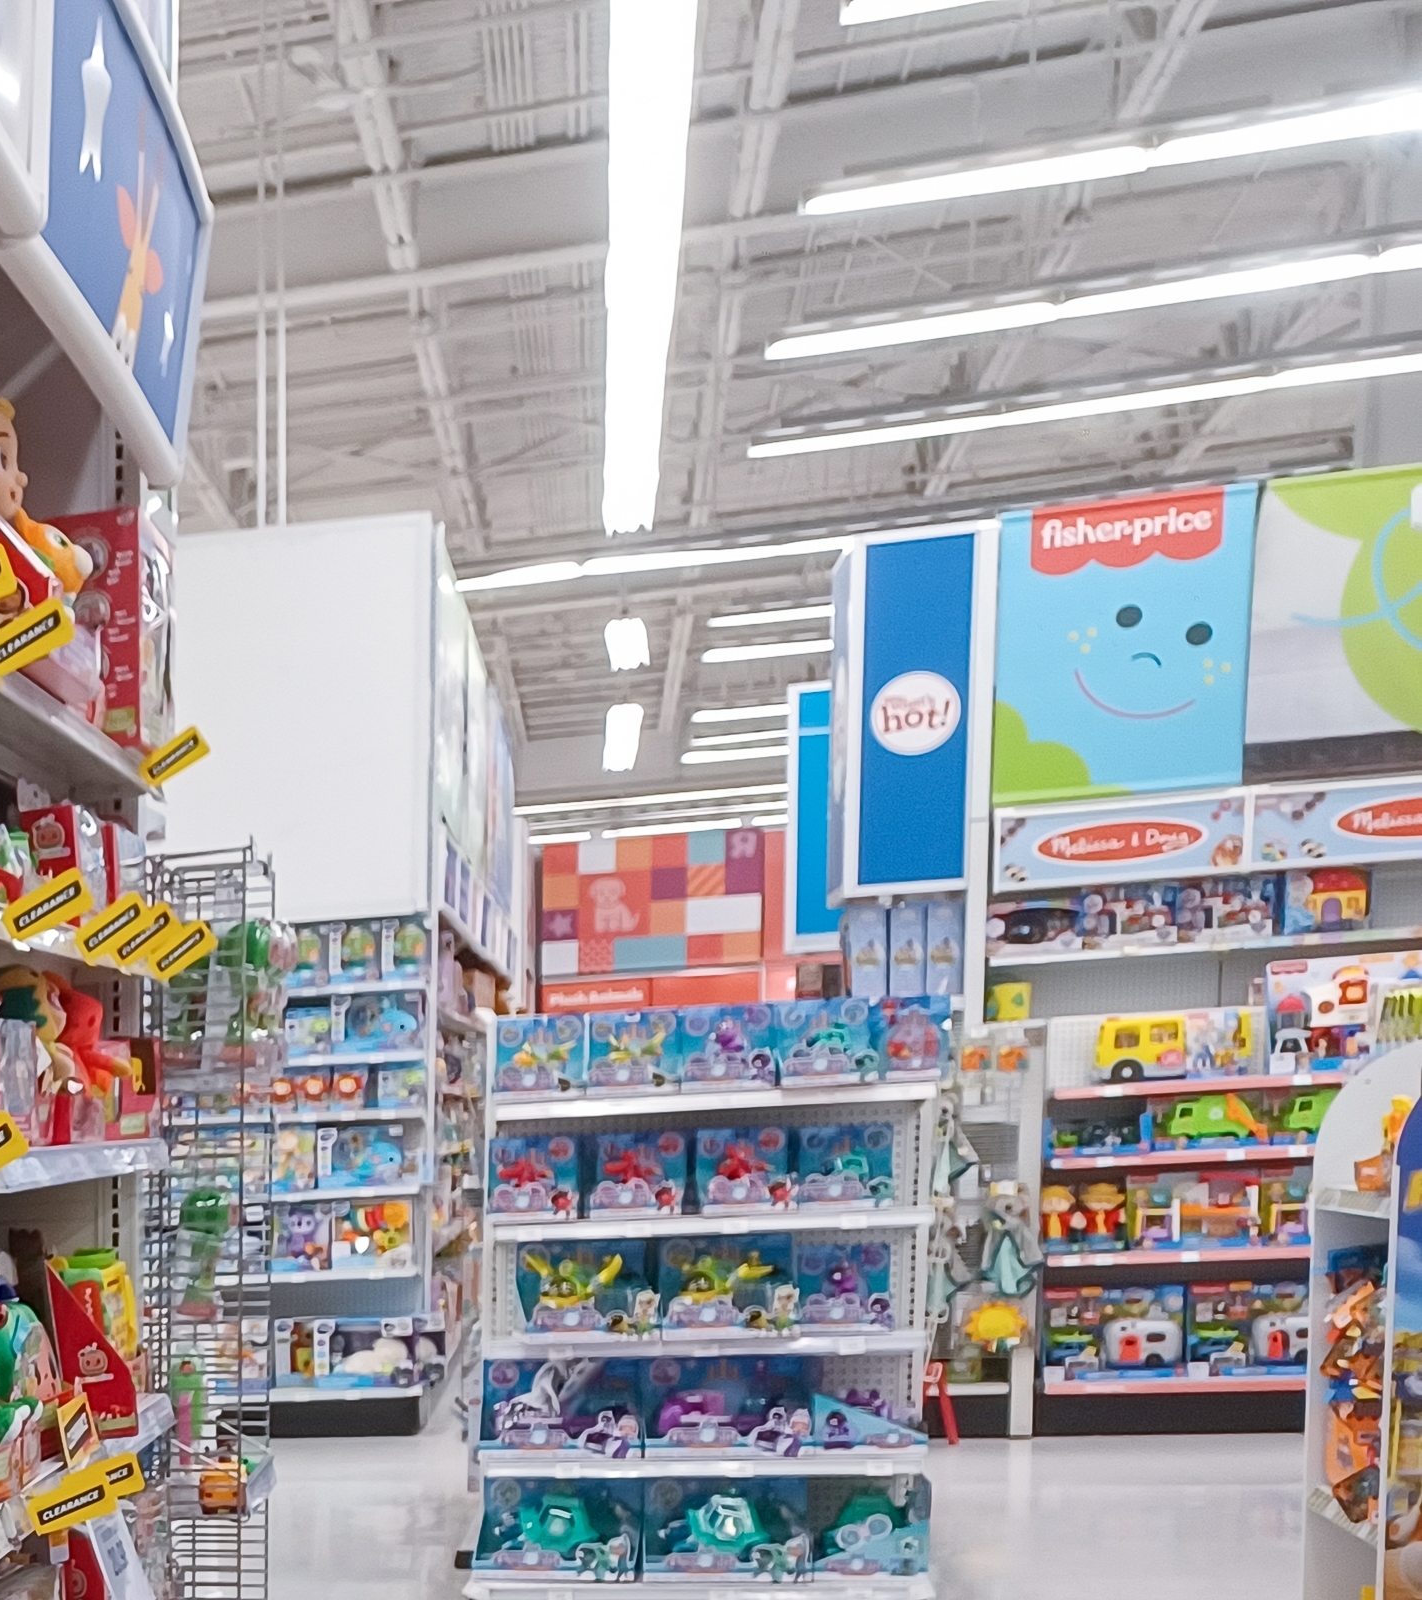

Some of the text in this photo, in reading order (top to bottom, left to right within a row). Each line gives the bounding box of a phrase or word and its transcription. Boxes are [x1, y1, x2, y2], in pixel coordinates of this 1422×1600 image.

[1041, 507, 1213, 551] fisher-price
[881, 699, 951, 733] hot!
[16, 880, 80, 929] CLEARANCE
[85, 904, 139, 953] CLEARANCE
[42, 1489, 101, 1521] CLEARANCE
